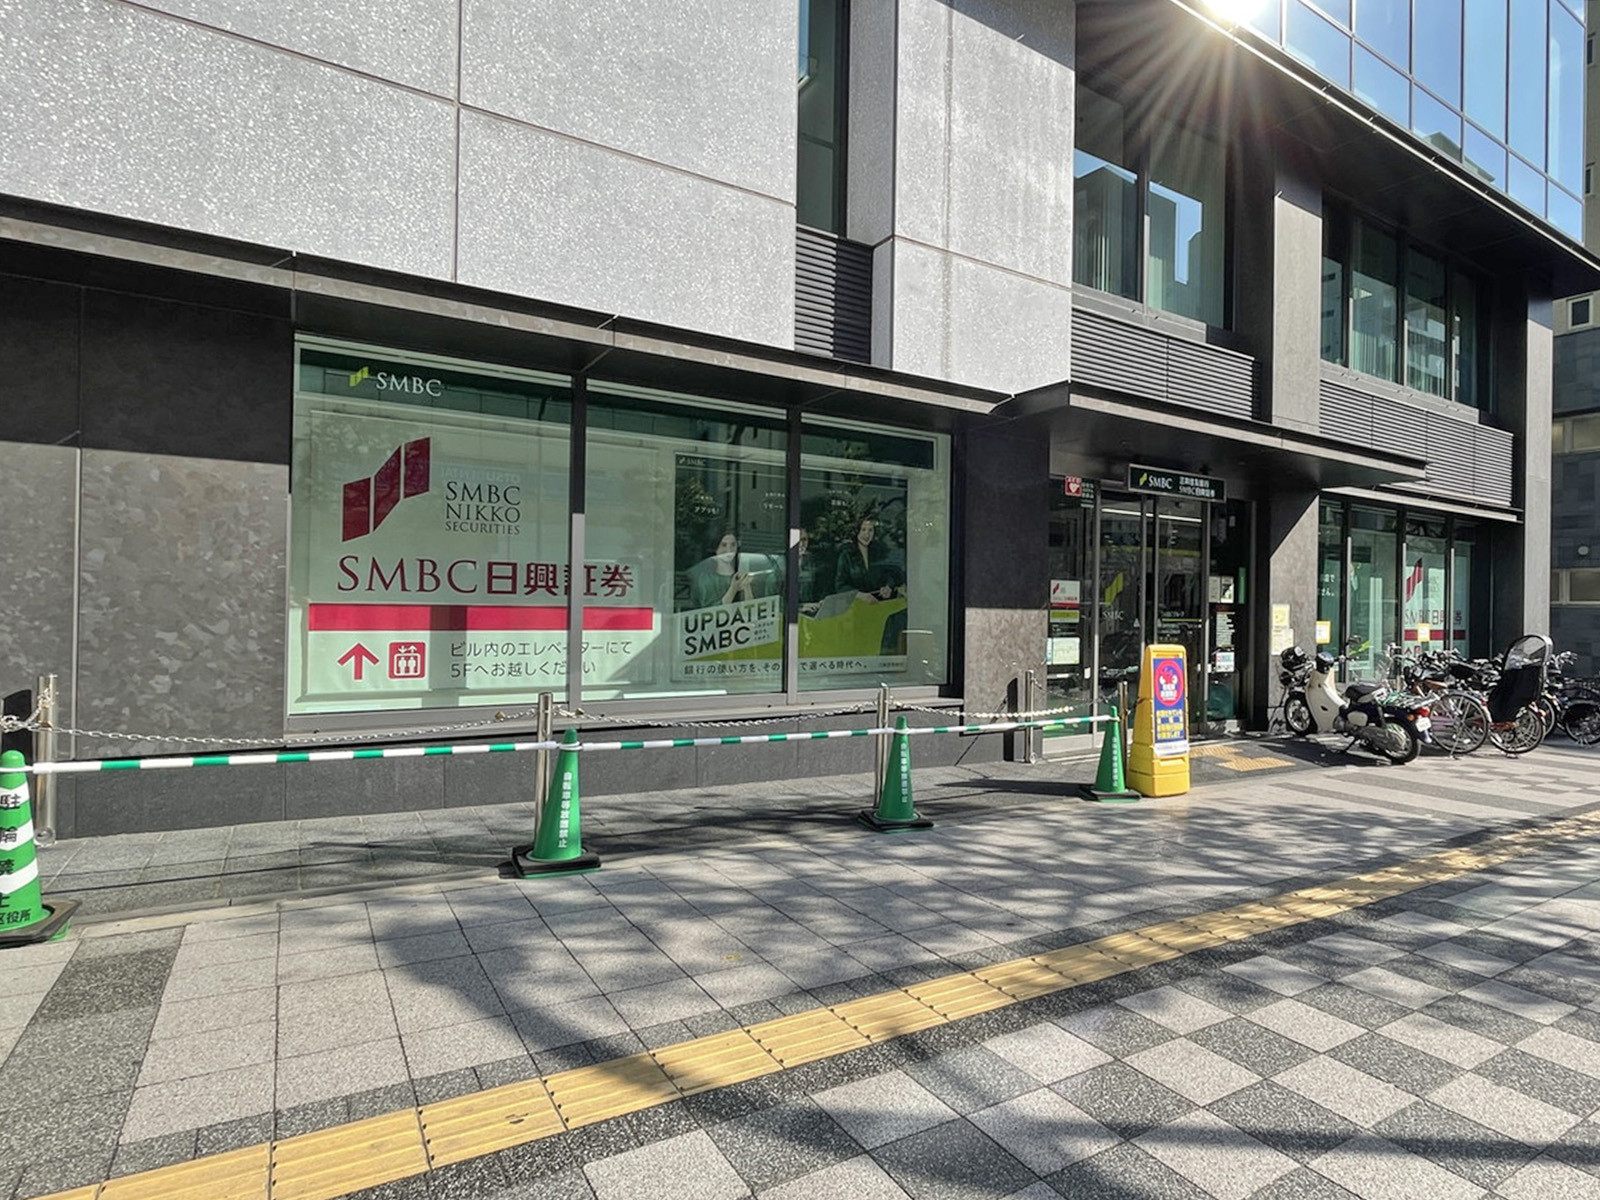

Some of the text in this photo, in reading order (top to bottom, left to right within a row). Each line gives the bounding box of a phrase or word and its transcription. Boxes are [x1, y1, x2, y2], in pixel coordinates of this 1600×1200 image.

[376, 372, 442, 397] SMBC
[446, 481, 521, 506] SMBC
[1148, 475, 1173, 490] SMBC
[446, 502, 521, 523] NIKKO
[445, 521, 520, 535] SECURITIES
[337, 555, 634, 597] SMBC日興証券
[685, 601, 776, 634] UPDATE!
[684, 626, 751, 656] SMBC
[450, 660, 596, 678] 5Fへお越しくだい
